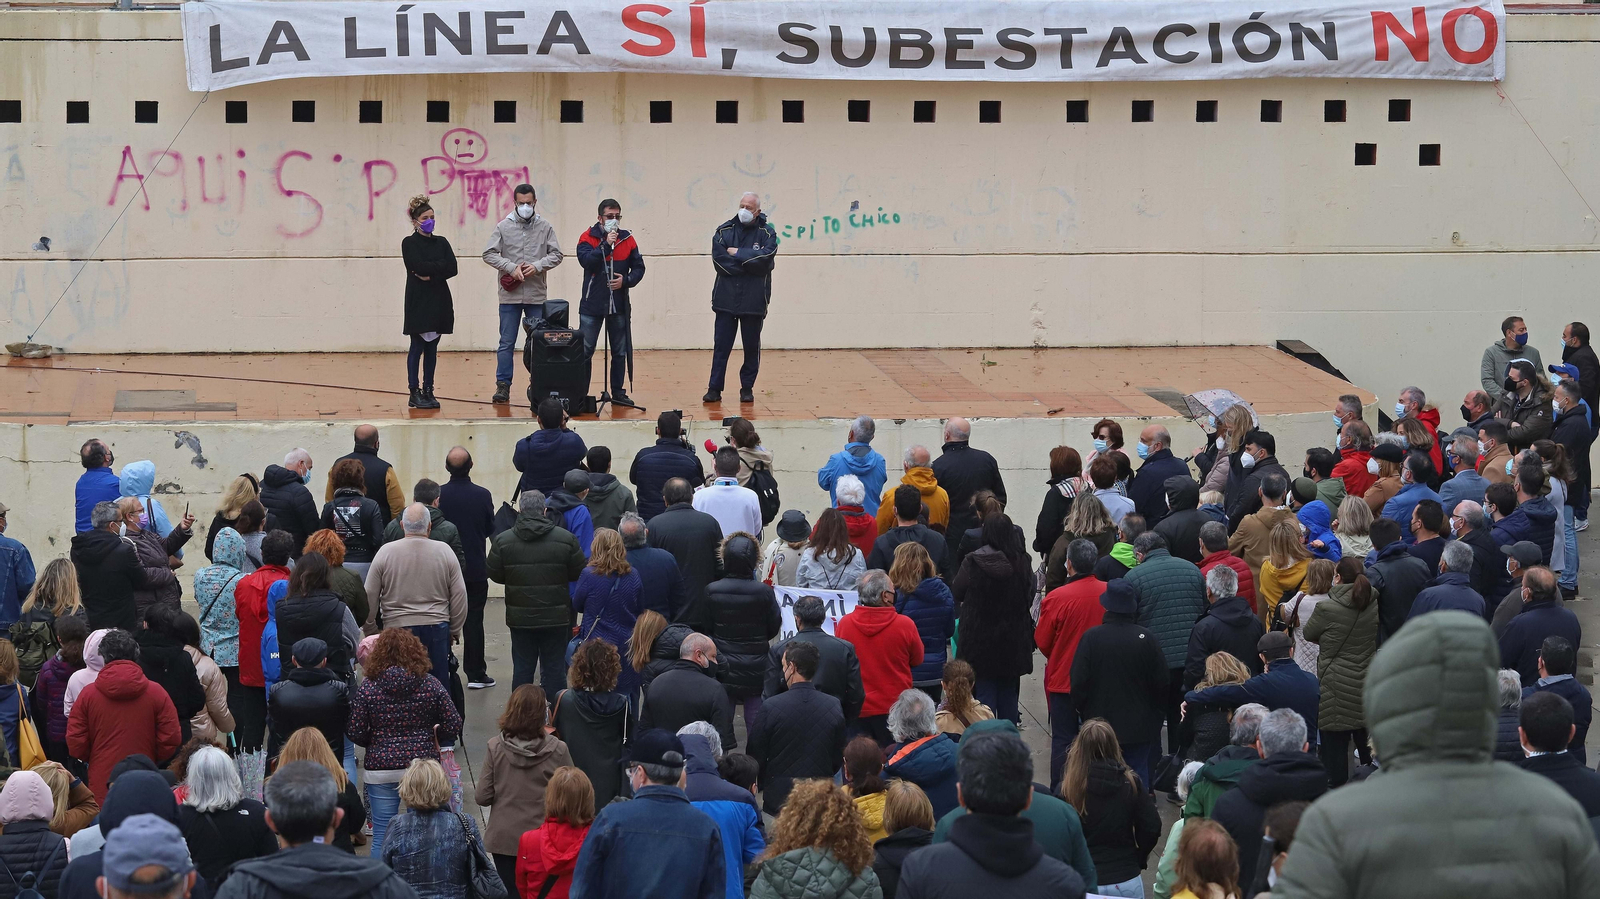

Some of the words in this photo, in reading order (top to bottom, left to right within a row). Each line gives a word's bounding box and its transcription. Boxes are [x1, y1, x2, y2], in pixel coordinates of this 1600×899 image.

[209, 21, 311, 73] LA
[344, 4, 591, 58] LÍNEA
[620, 0, 738, 70] SÍ,
[775, 12, 1338, 69] SUBESTACIÓN
[1370, 6, 1499, 64] NO
